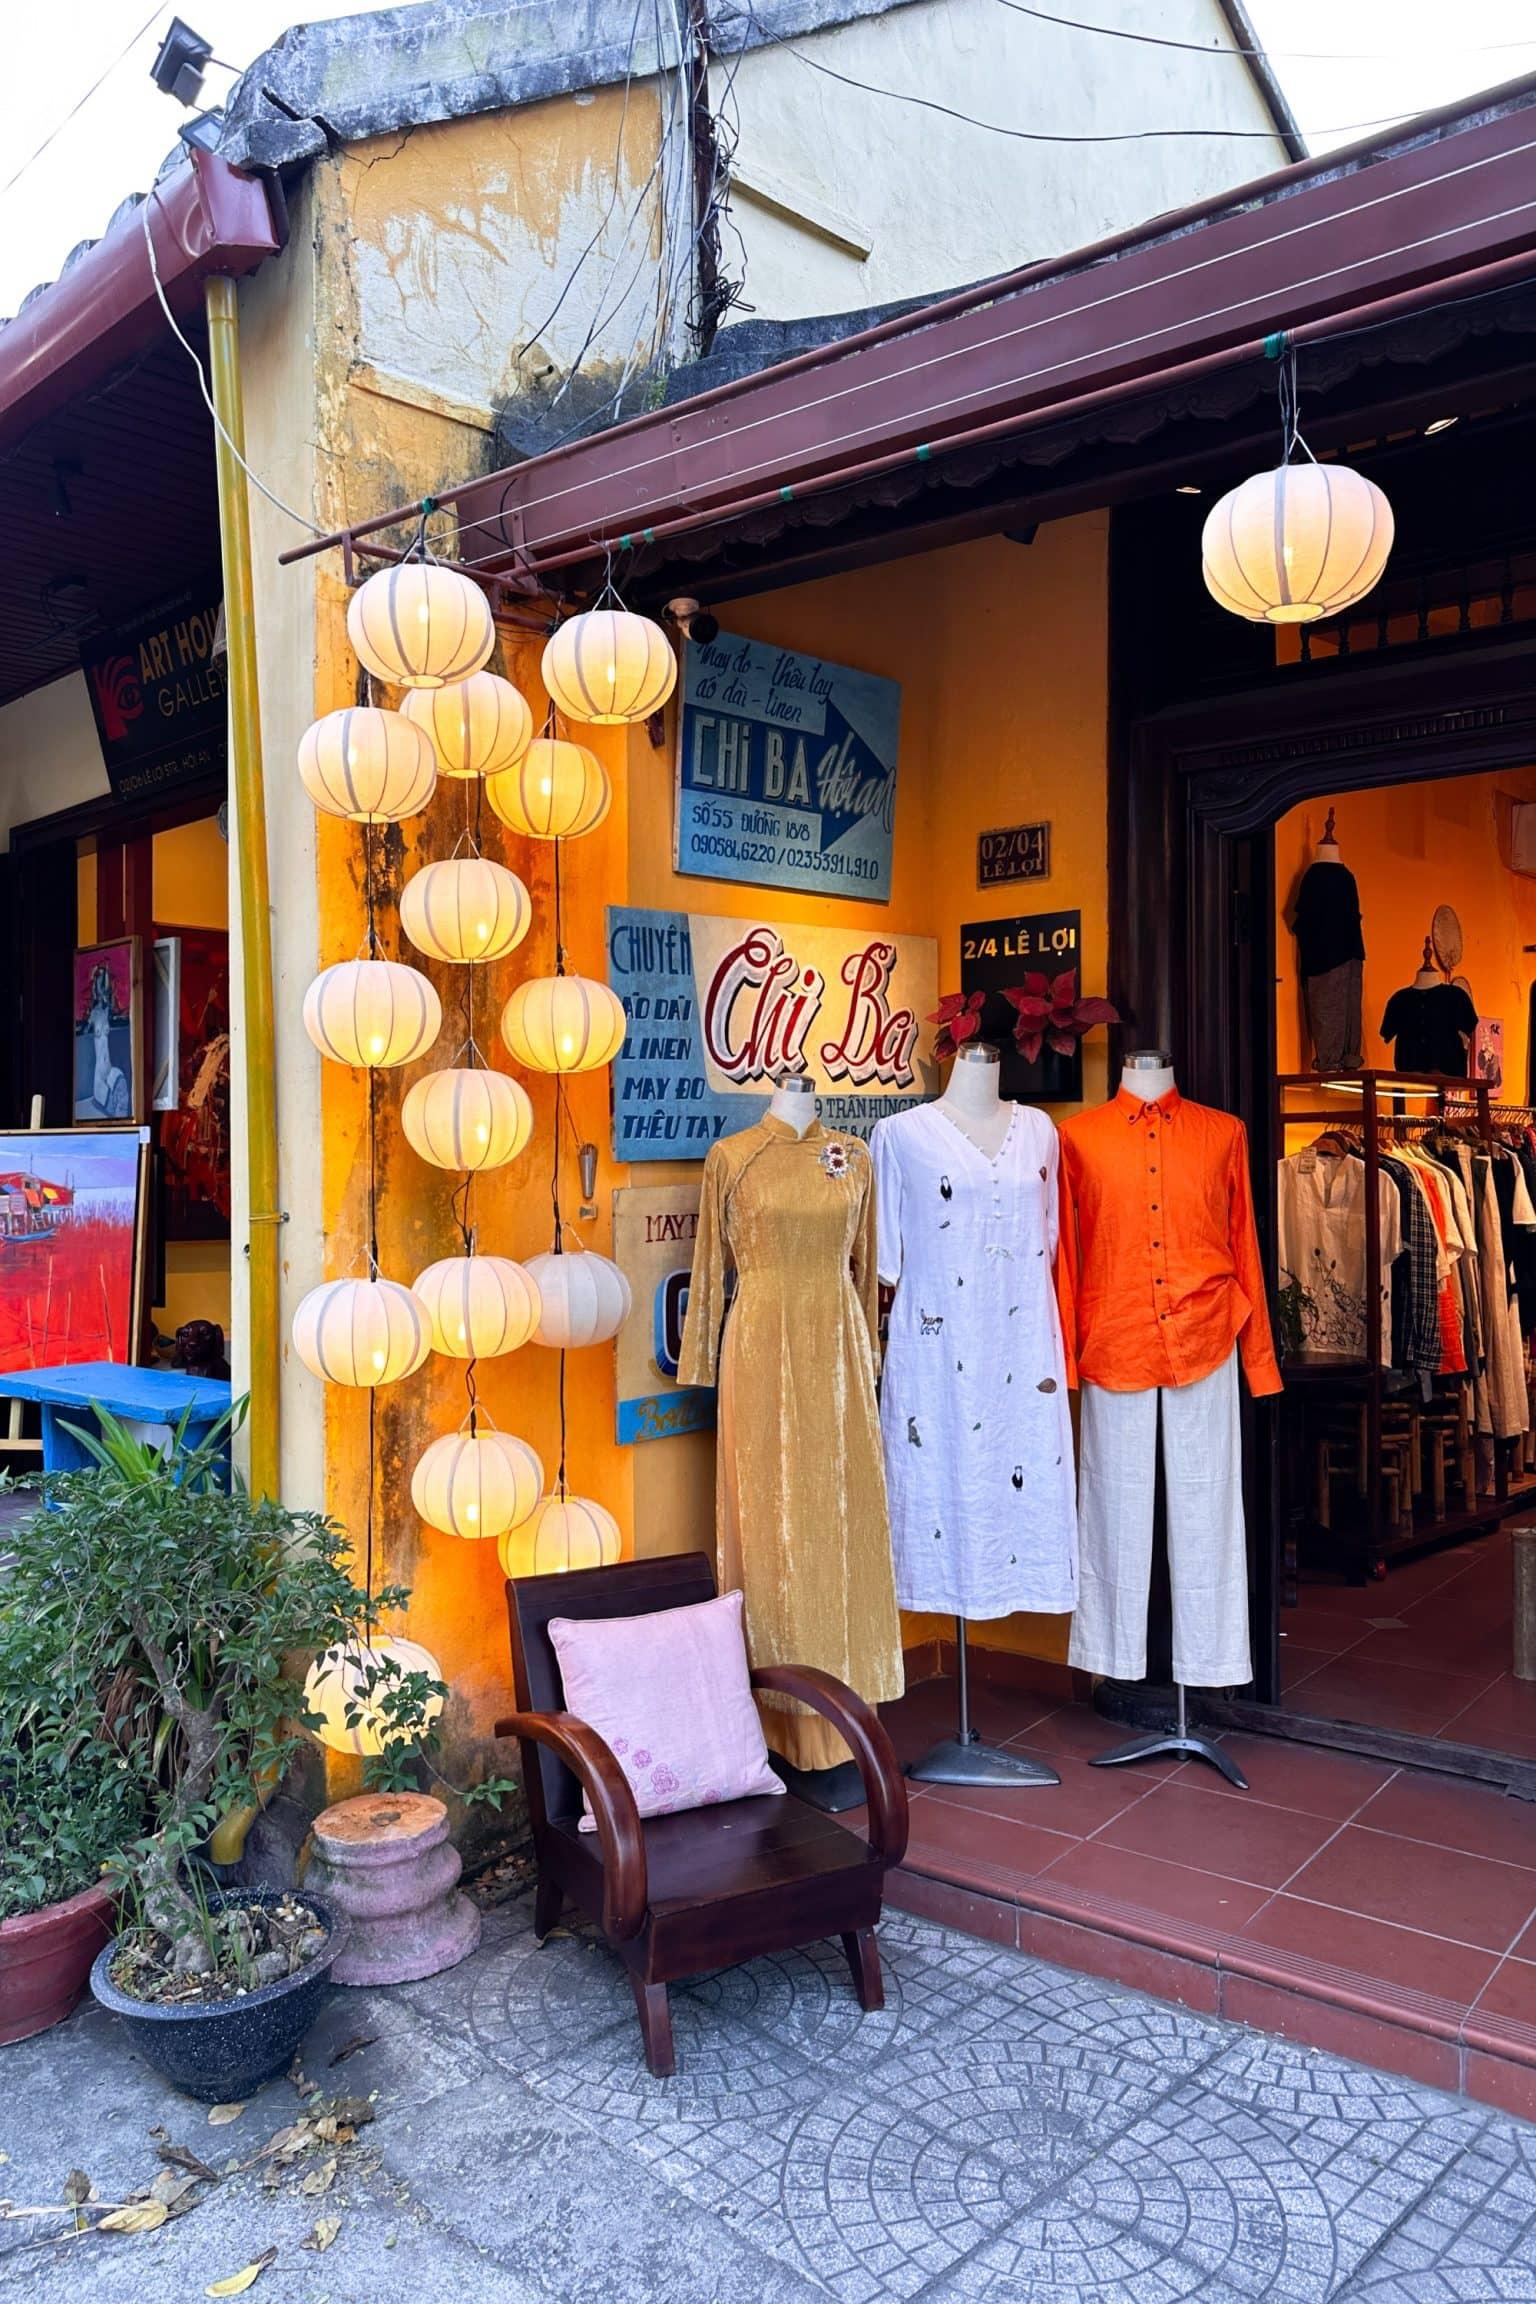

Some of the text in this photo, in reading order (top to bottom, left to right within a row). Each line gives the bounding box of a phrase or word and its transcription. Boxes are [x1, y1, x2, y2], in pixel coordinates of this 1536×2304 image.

[137, 631, 174, 684] ART
[763, 729, 811, 805] BA
[786, 821, 810, 842] 18/8
[982, 830, 1044, 861] 02/04
[610, 924, 691, 975] CHUYÊN
[964, 927, 1076, 959] 2/4 LÊ LỢI
[704, 926, 917, 1082] Chi Ba
[622, 1037, 692, 1060] LINEN
[622, 1077, 706, 1100] MAY ĐO
[622, 1108, 728, 1139] THÊU TAY
